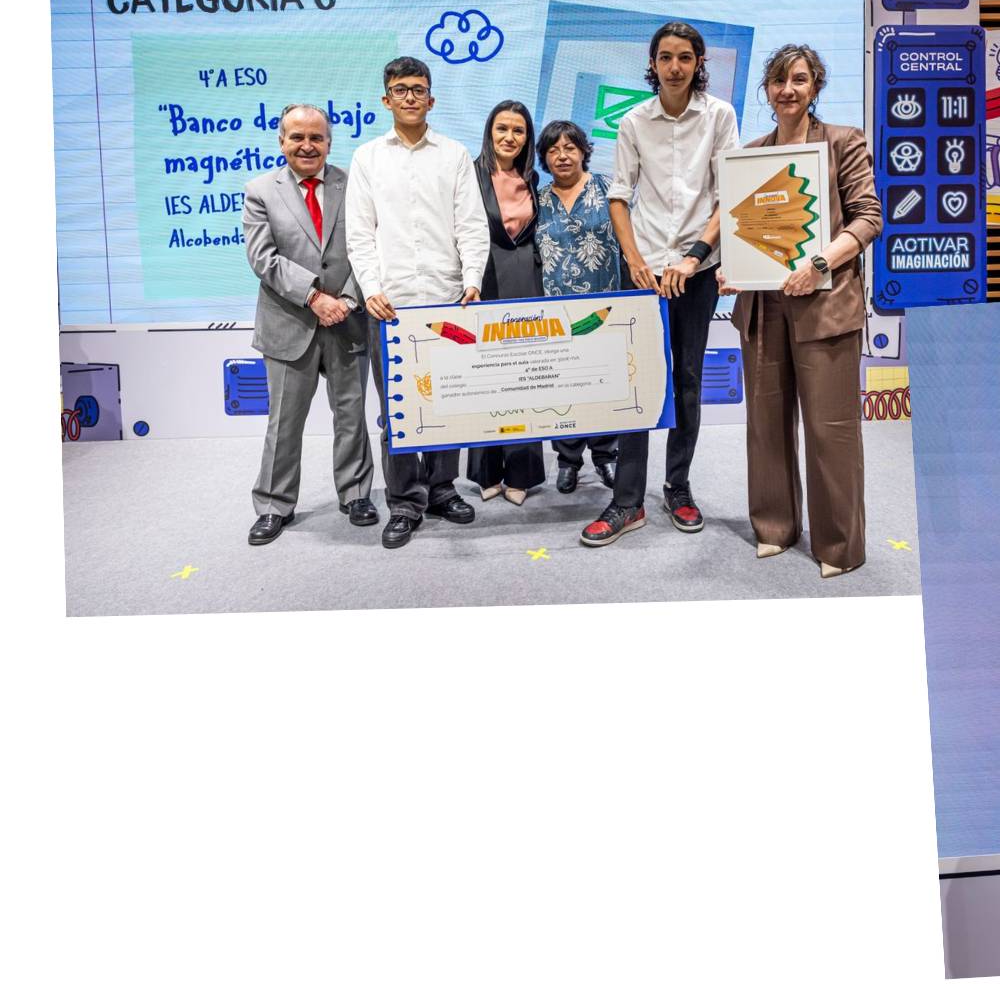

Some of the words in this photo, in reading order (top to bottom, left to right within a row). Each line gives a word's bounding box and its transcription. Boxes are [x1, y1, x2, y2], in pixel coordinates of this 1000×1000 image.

[900, 52, 964, 62] CONTROL
[900, 62, 963, 72] CENTRAL
[235, 67, 268, 87] ESO
[941, 96, 969, 119] 11:11
[253, 102, 280, 132] de
[328, 100, 376, 138] bajo
[165, 147, 288, 185] magnético
[165, 195, 192, 216] IES
[199, 192, 245, 215] ALDE
[891, 237, 969, 253] ACTIVAR
[891, 252, 970, 269] IMAGINACIÓN
[482, 318, 566, 343] INNOVA
[501, 385, 530, 393] Comunidad
[559, 422, 576, 430] ONCE
